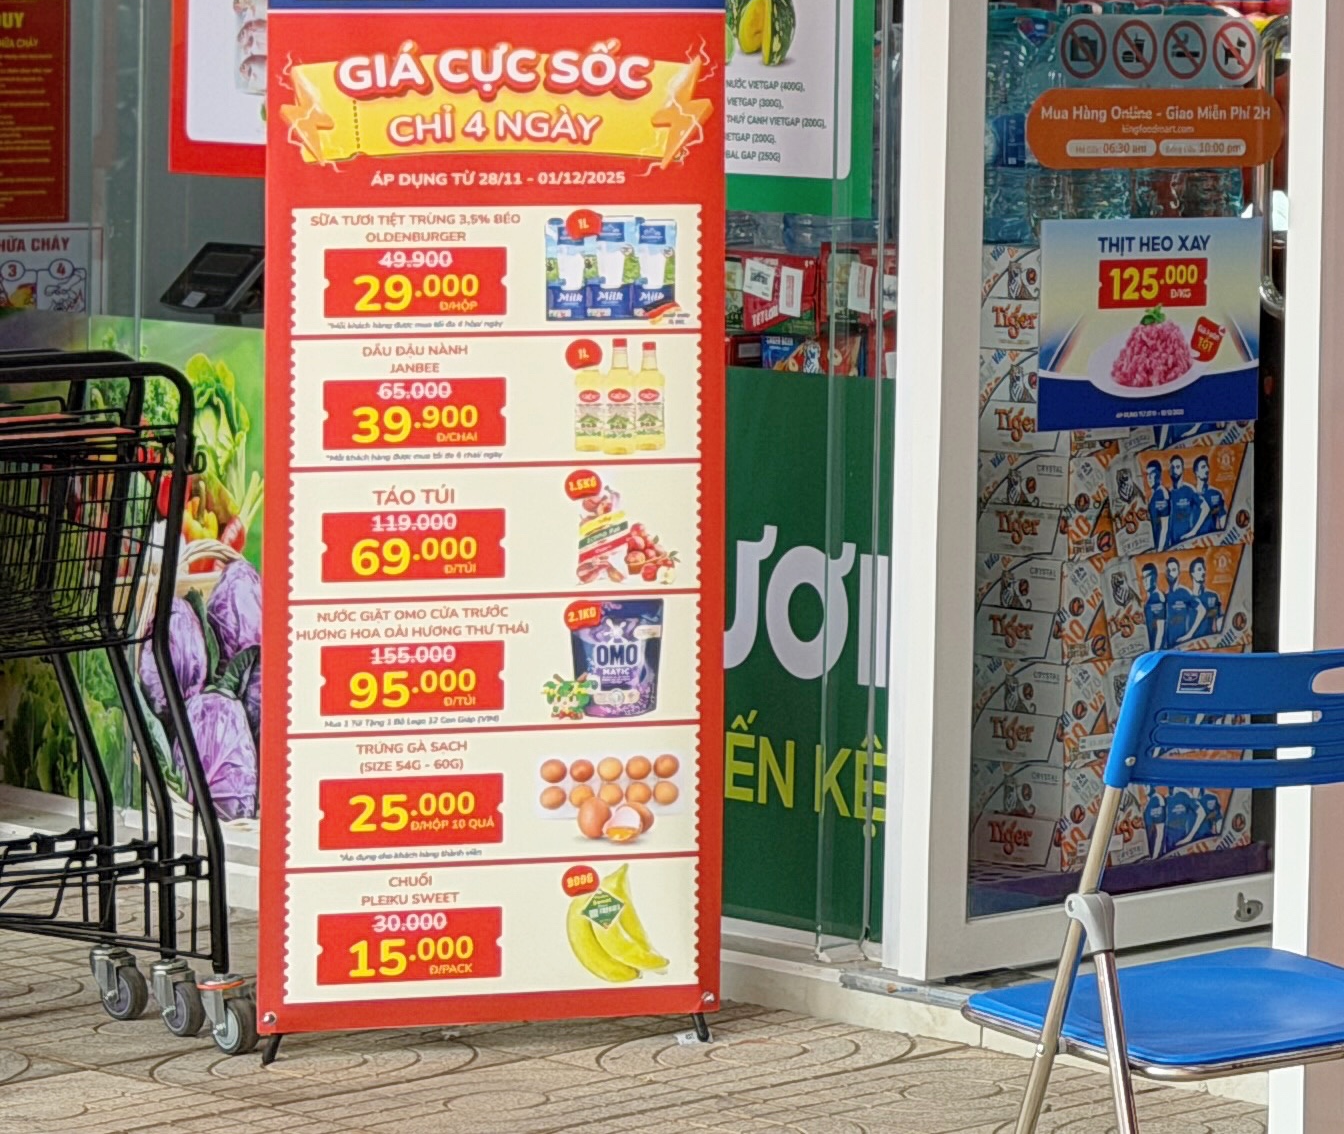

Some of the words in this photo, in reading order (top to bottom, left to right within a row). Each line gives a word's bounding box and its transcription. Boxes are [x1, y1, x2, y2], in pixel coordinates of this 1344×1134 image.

[339, 41, 423, 90] GIÁ
[439, 43, 537, 94] CỰC
[550, 39, 650, 90] SỐC
[1041, 107, 1069, 120] Mua
[1072, 105, 1107, 123] Hàng
[389, 105, 454, 145] CHỈ
[465, 111, 486, 138] 4
[499, 106, 601, 142] NGÀY
[371, 170, 395, 186] ÁP
[399, 172, 448, 190] DỤNG
[451, 169, 476, 186] TỪ
[478, 172, 521, 186] 28/11
[538, 170, 625, 186] 01/12/2025
[365, 231, 466, 243] OLDENBURGER
[1098, 236, 1134, 256] THỊT
[1139, 235, 1173, 252] HEO
[1178, 235, 1211, 251] XAY
[378, 251, 453, 268] 49.900
[1109, 264, 1198, 300] 125.000
[354, 274, 478, 312] 29.000
[992, 304, 1037, 339] Tiger
[390, 363, 440, 374] JANBEE
[377, 381, 452, 400] 65.000
[352, 404, 479, 444] 39.900
[372, 487, 416, 506] TÁO
[421, 486, 455, 505] TÚI
[370, 513, 457, 533] 119.000
[350, 536, 478, 578] 69.000
[370, 645, 456, 665] 155.000
[596, 644, 638, 666] OMO
[349, 668, 477, 709] 95.000
[356, 739, 404, 755] TRỨNG
[407, 740, 427, 753] GÀ
[431, 740, 468, 755] SẠCH
[349, 791, 475, 832] 25.000
[389, 873, 433, 887] CHUỐI
[412, 892, 460, 904] SWEET
[372, 913, 447, 933] 30.000
[349, 936, 474, 978] 15.000
